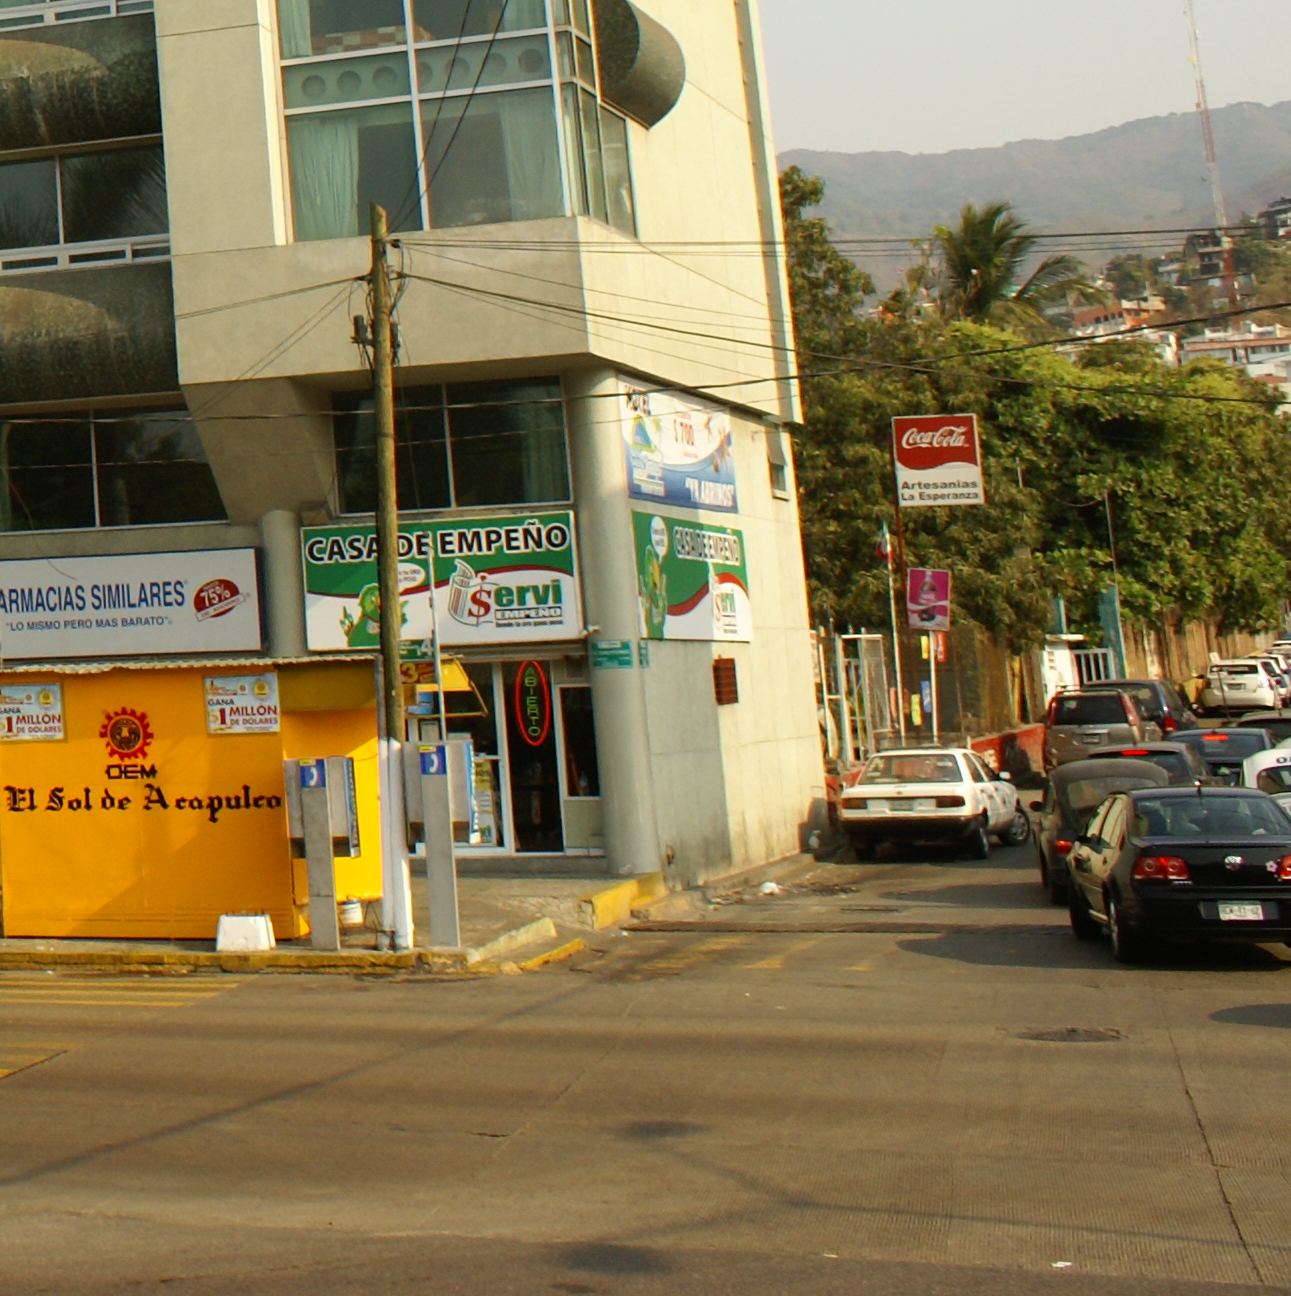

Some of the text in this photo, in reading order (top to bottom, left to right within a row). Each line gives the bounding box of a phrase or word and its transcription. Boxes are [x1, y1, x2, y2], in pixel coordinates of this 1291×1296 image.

[901, 425, 968, 449] Coca-Cola
[901, 480, 978, 490] Artesanias
[901, 491, 978, 502] La Esperanza
[438, 520, 569, 556] EMPEÑO
[90, 580, 186, 611] SIMILARES
[200, 585, 231, 608] 75%
[495, 607, 563, 620] EMPEÑO
[26, 619, 61, 631] MISMO
[63, 618, 93, 630] PERO
[95, 617, 119, 629] MAS
[207, 698, 235, 706] GANA
[524, 666, 541, 737] ABIERTO
[105, 763, 158, 780] OEM
[3, 783, 282, 824] El Sol de Acapulco
